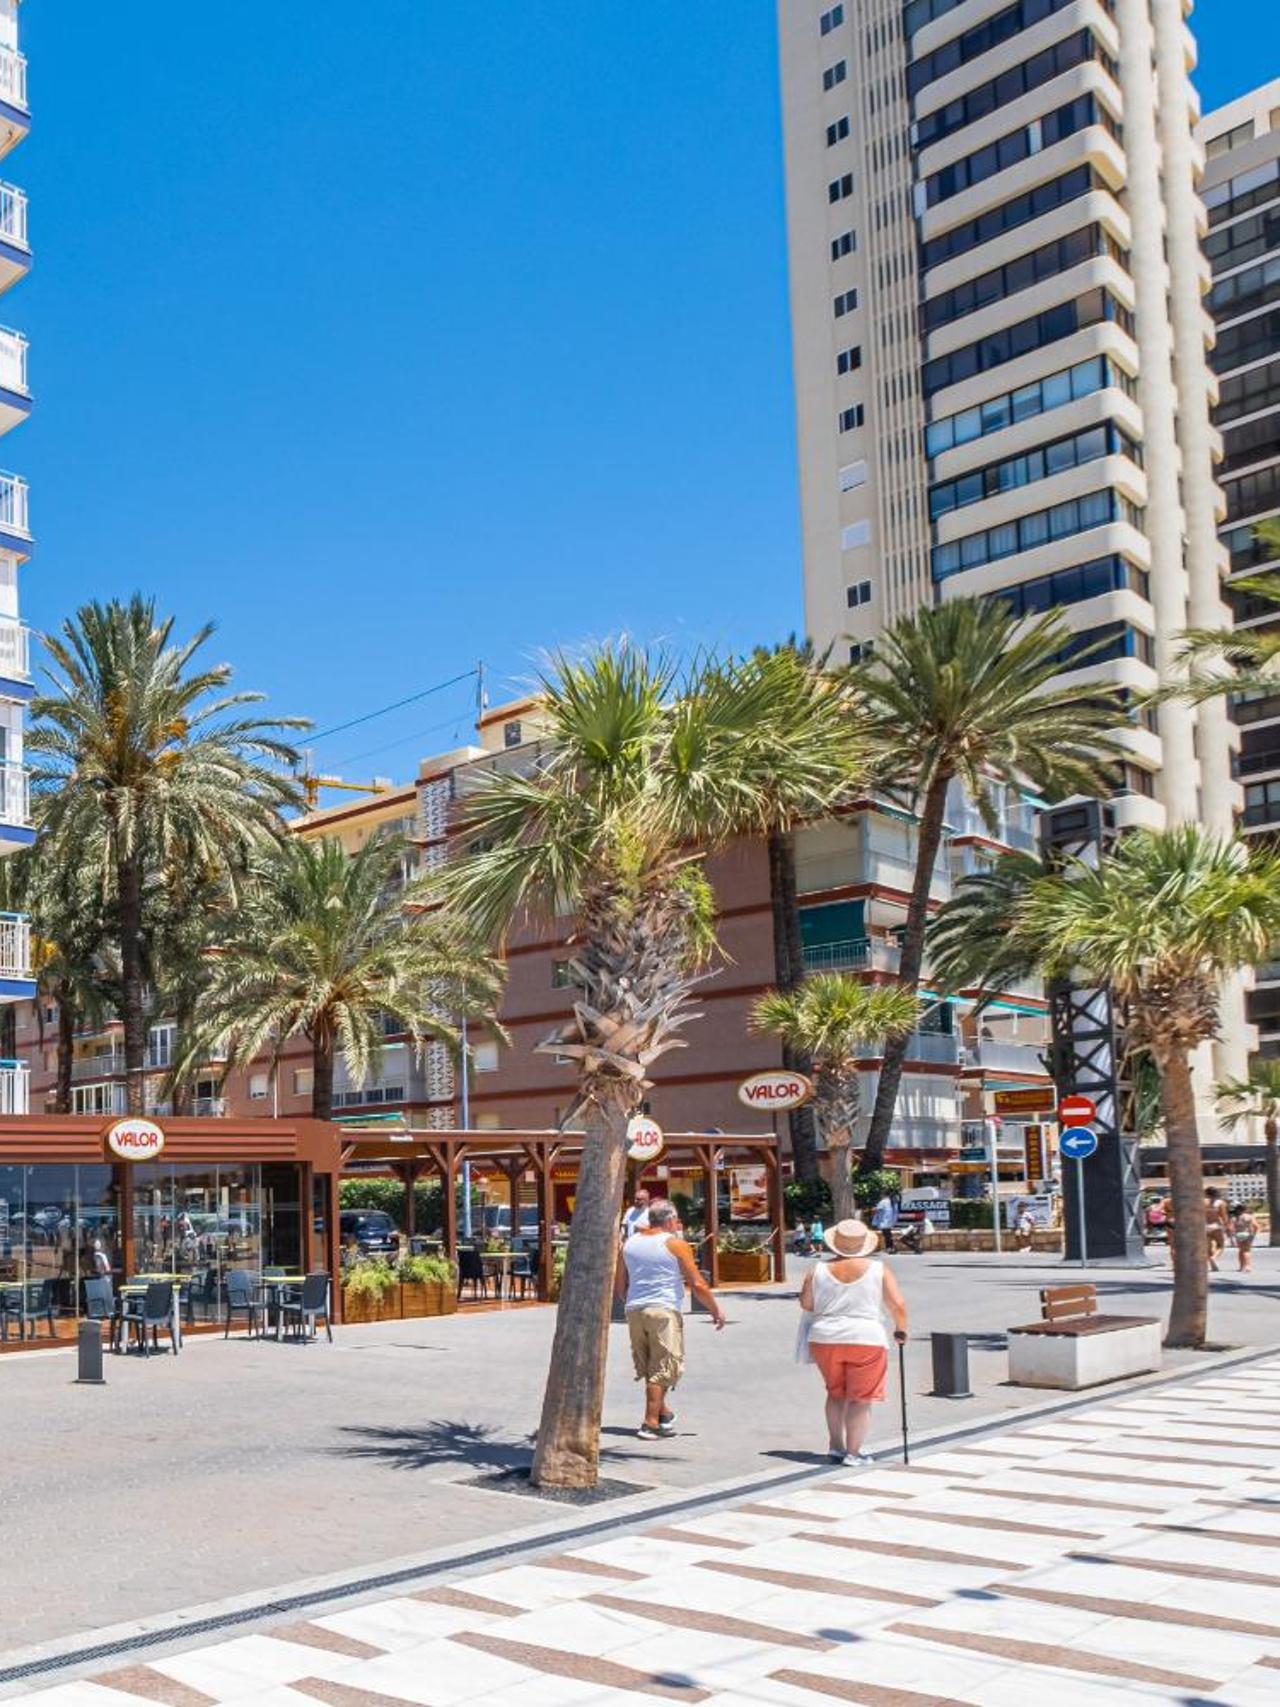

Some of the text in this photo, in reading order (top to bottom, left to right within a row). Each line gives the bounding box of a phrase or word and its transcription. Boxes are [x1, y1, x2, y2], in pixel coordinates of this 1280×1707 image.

[744, 1083, 800, 1100] VALOR
[114, 1131, 158, 1147] VALOR
[634, 1131, 658, 1147] ALOR
